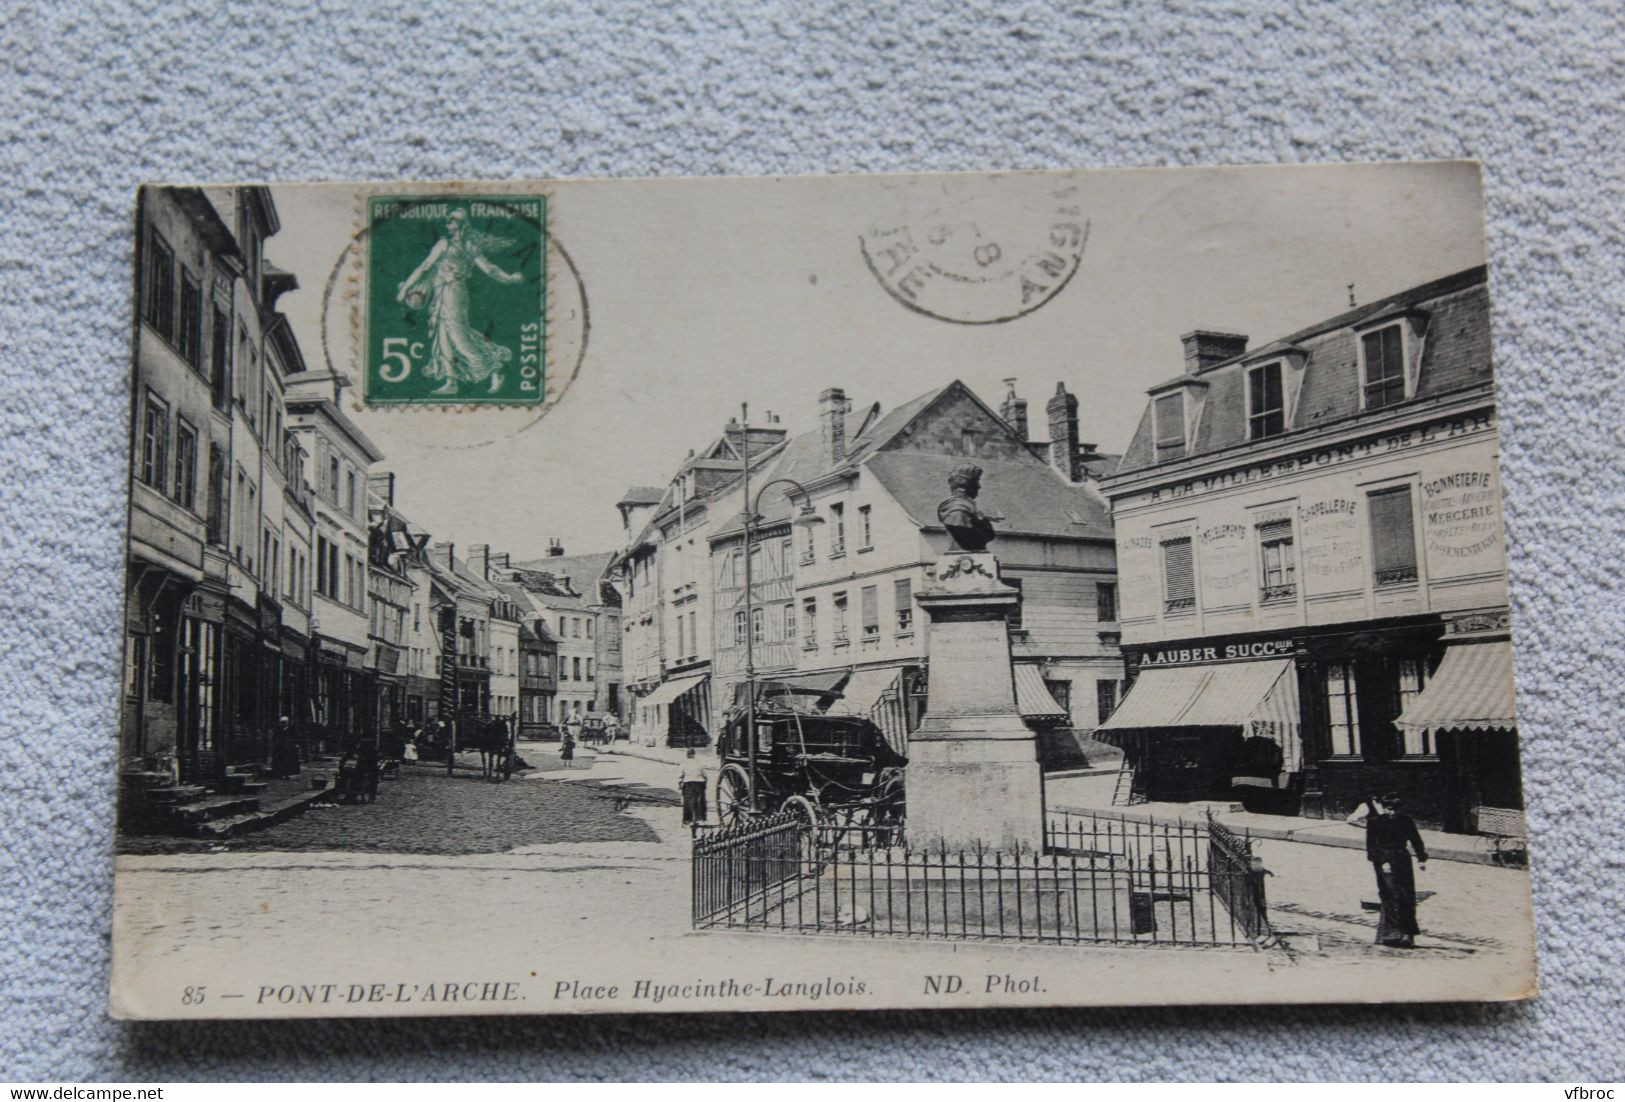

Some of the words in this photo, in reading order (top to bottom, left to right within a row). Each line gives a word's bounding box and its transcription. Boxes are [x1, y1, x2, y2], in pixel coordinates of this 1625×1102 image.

[519, 322, 538, 391] POSTES
[1298, 441, 1379, 470] PONT
[1386, 432, 1413, 450] DE
[1423, 471, 1491, 498] BONNETERIE
[1428, 504, 1495, 527] MERCERIE
[181, 986, 206, 1006] 85
[553, 980, 619, 1001] Place
[985, 974, 1048, 995] Phot.
